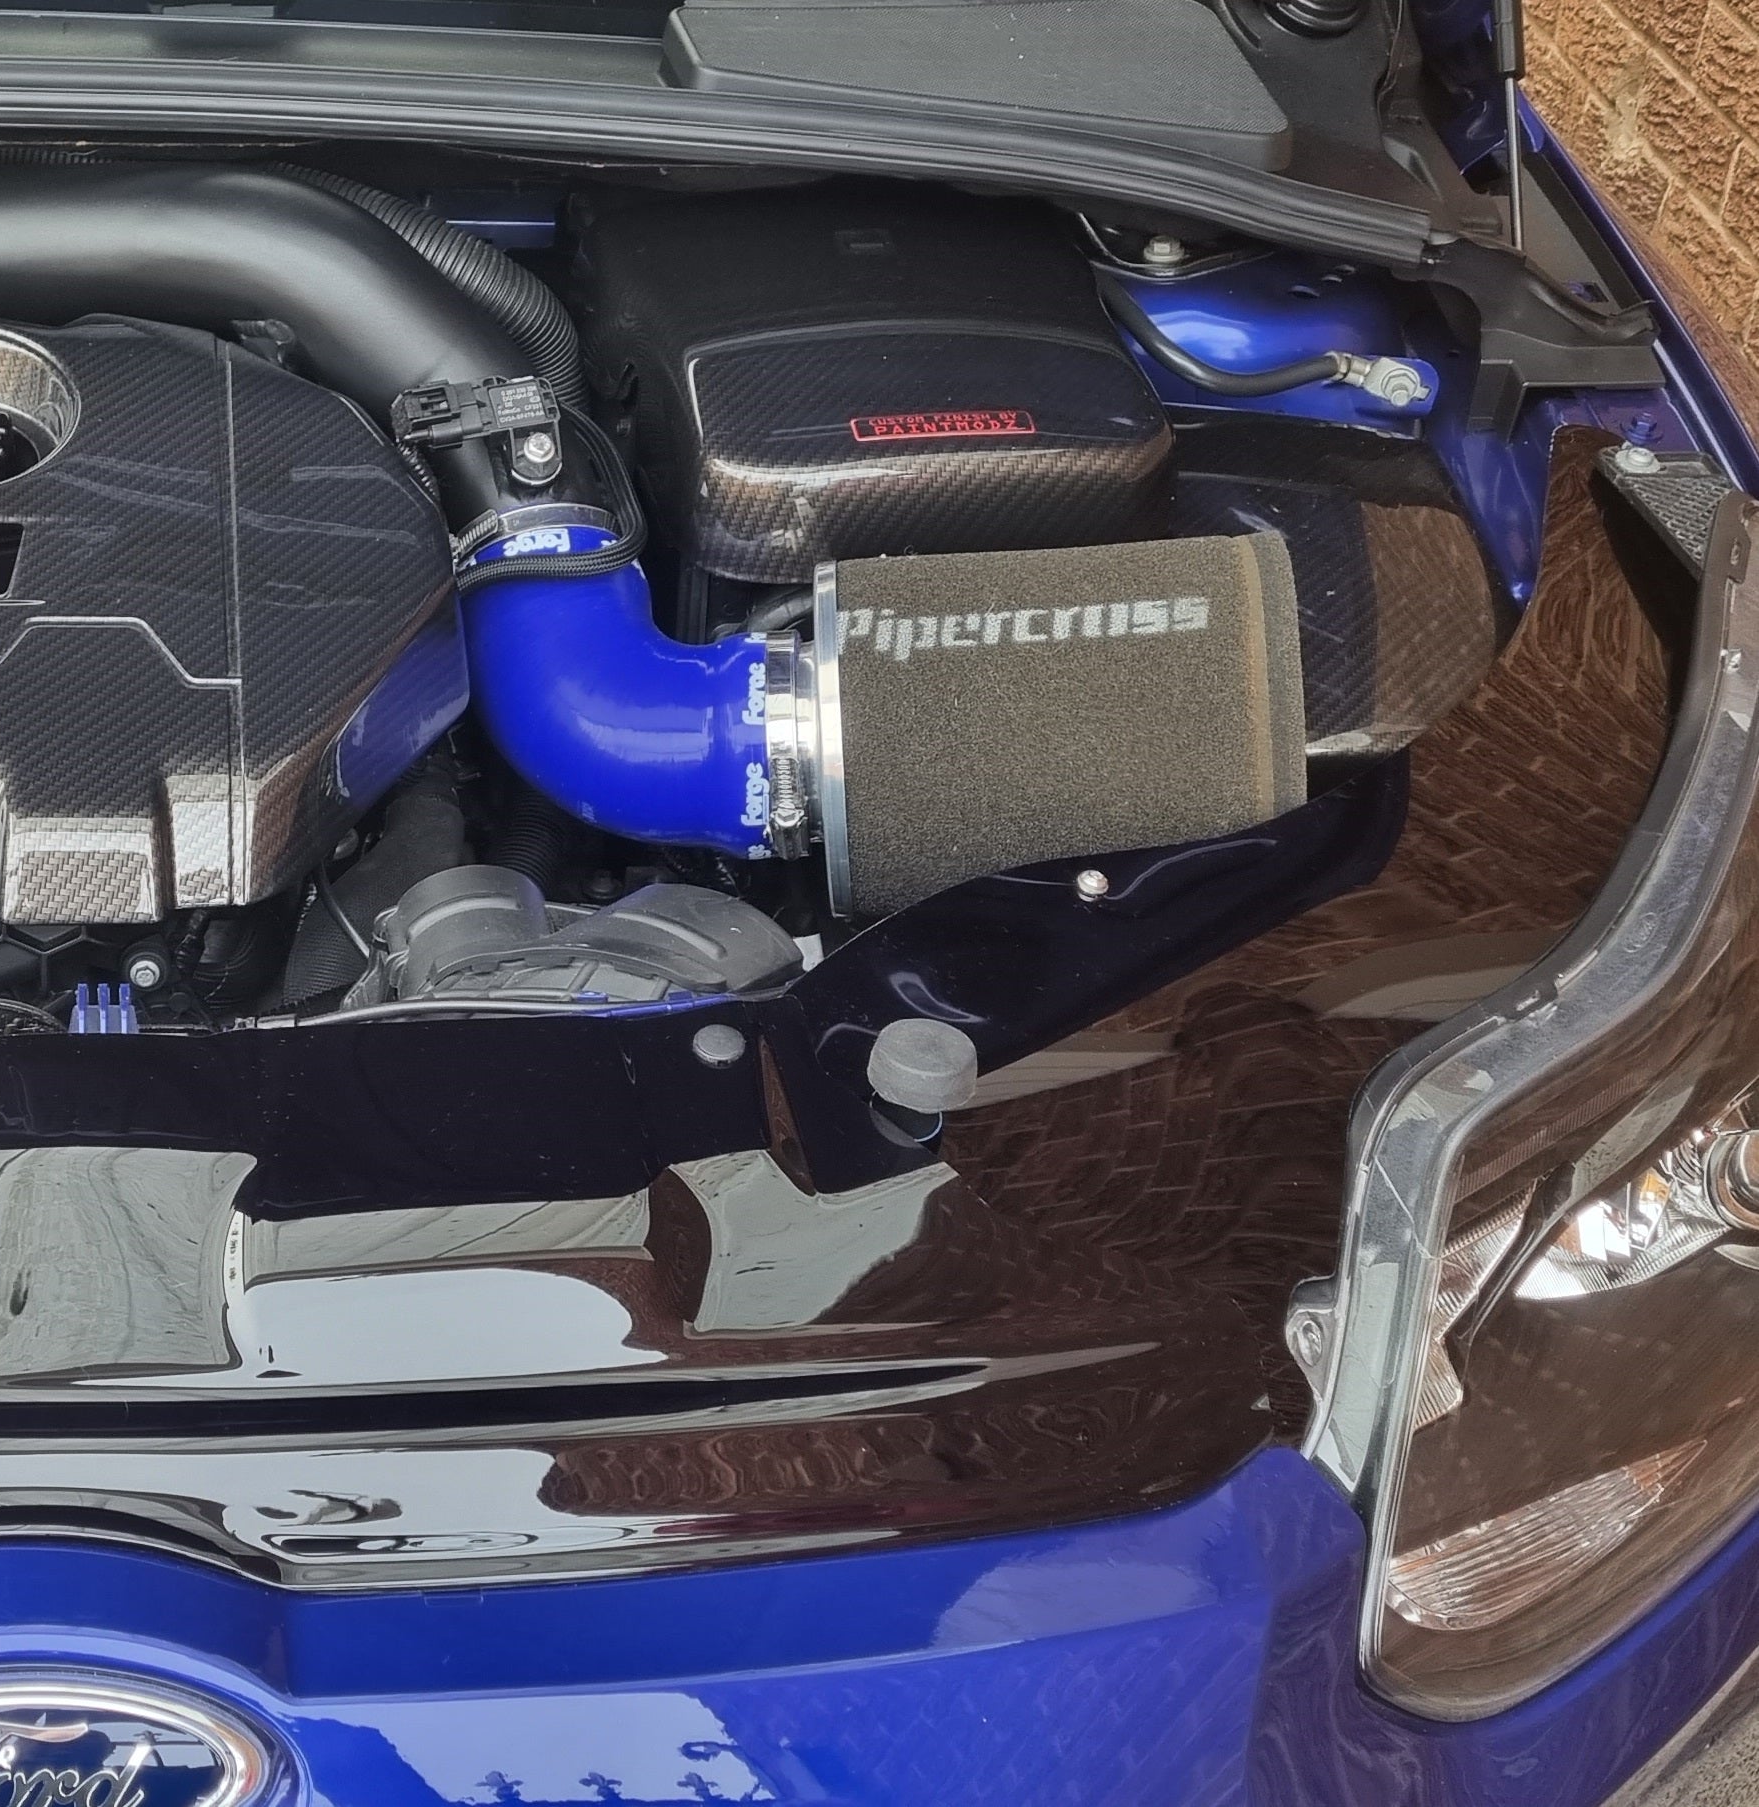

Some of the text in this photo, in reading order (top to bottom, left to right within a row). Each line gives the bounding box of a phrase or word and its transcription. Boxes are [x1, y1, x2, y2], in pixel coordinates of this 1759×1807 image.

[869, 410, 1017, 426] CUSTOM FINISH BY
[874, 420, 1022, 436] PAINTMODZ
[503, 528, 571, 557] forge
[836, 597, 1211, 662] Pipercross
[741, 762, 770, 827] forge
